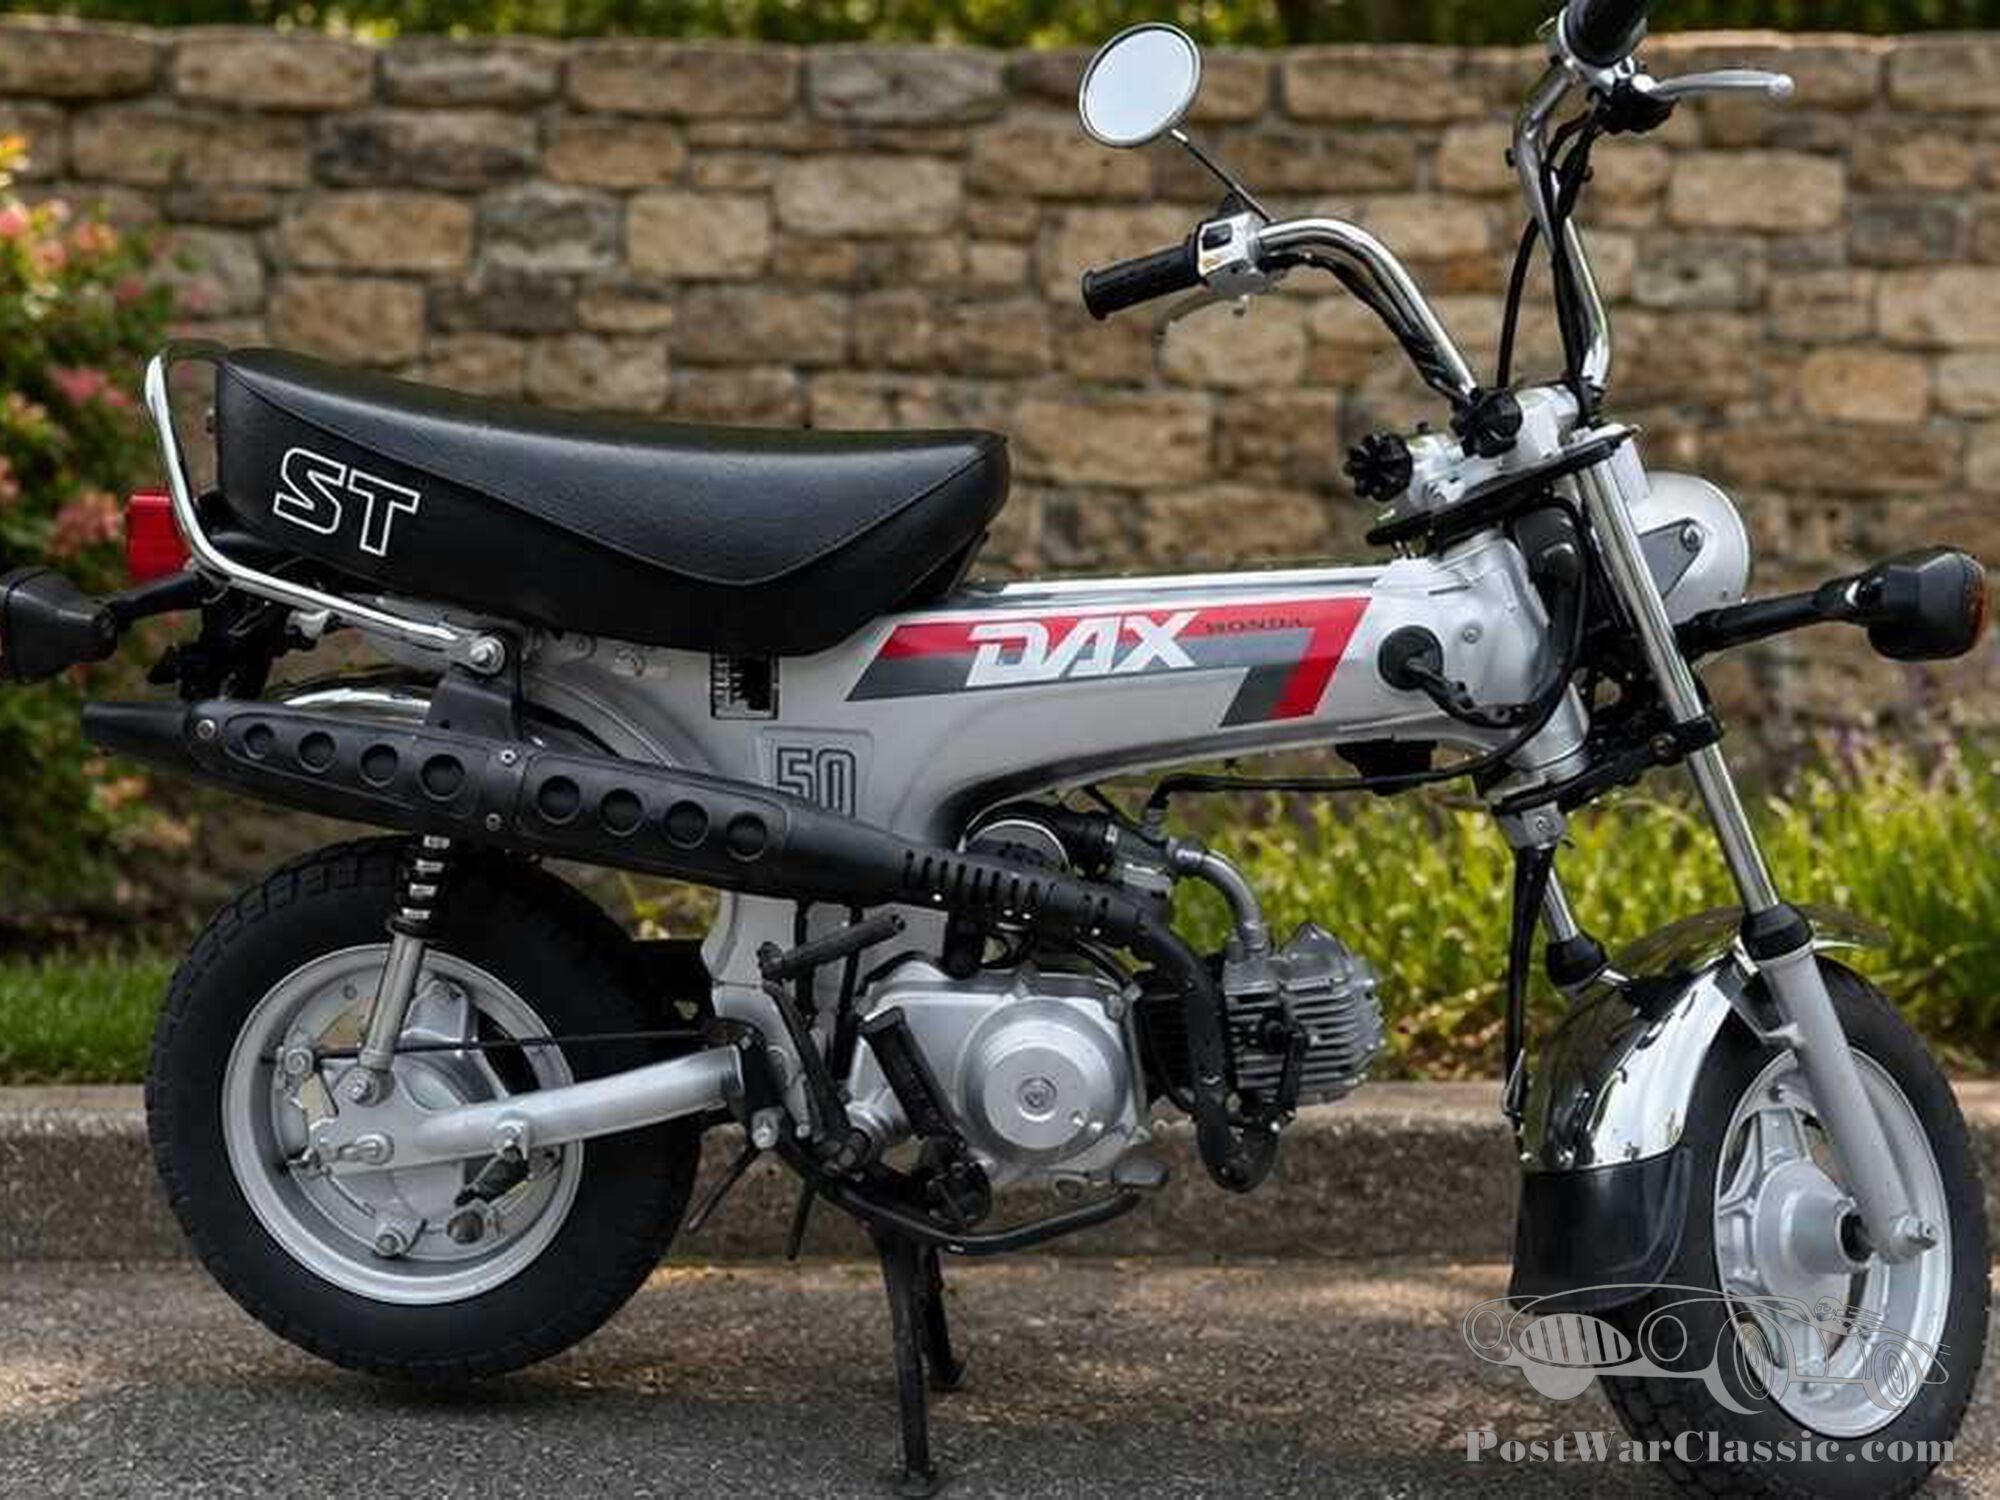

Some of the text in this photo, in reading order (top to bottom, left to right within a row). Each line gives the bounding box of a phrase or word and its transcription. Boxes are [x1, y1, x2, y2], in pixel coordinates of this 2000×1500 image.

[273, 447, 421, 557] ST
[965, 610, 1199, 688] DAX
[1205, 617, 1304, 635] HONDA
[777, 746, 857, 818] 50
